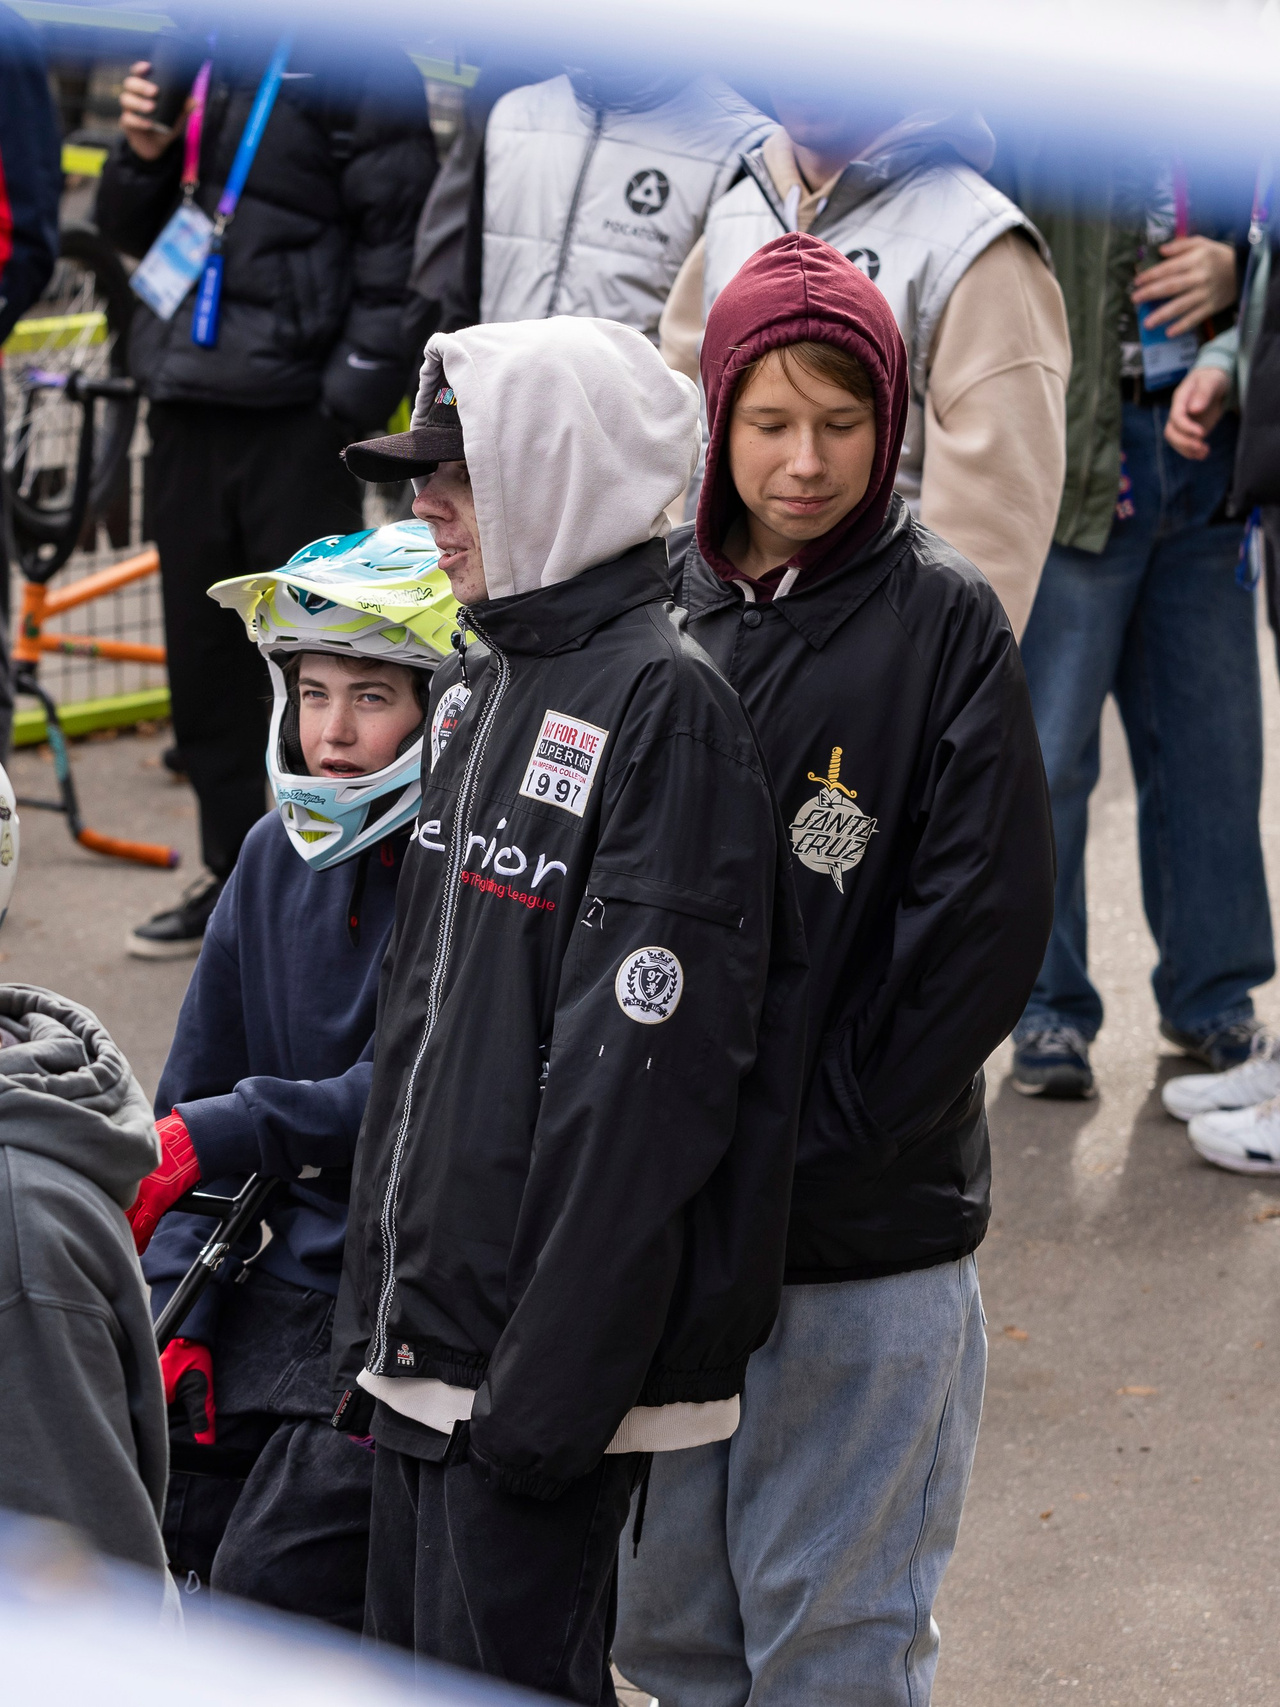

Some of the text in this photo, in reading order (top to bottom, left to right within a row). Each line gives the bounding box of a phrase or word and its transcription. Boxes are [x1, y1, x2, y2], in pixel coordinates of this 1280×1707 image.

[554, 723, 578, 746] FOR
[526, 769, 582, 808] 1997
[789, 809, 878, 840] SANTA
[792, 832, 867, 862] CRUZ
[646, 970, 663, 984] 97
